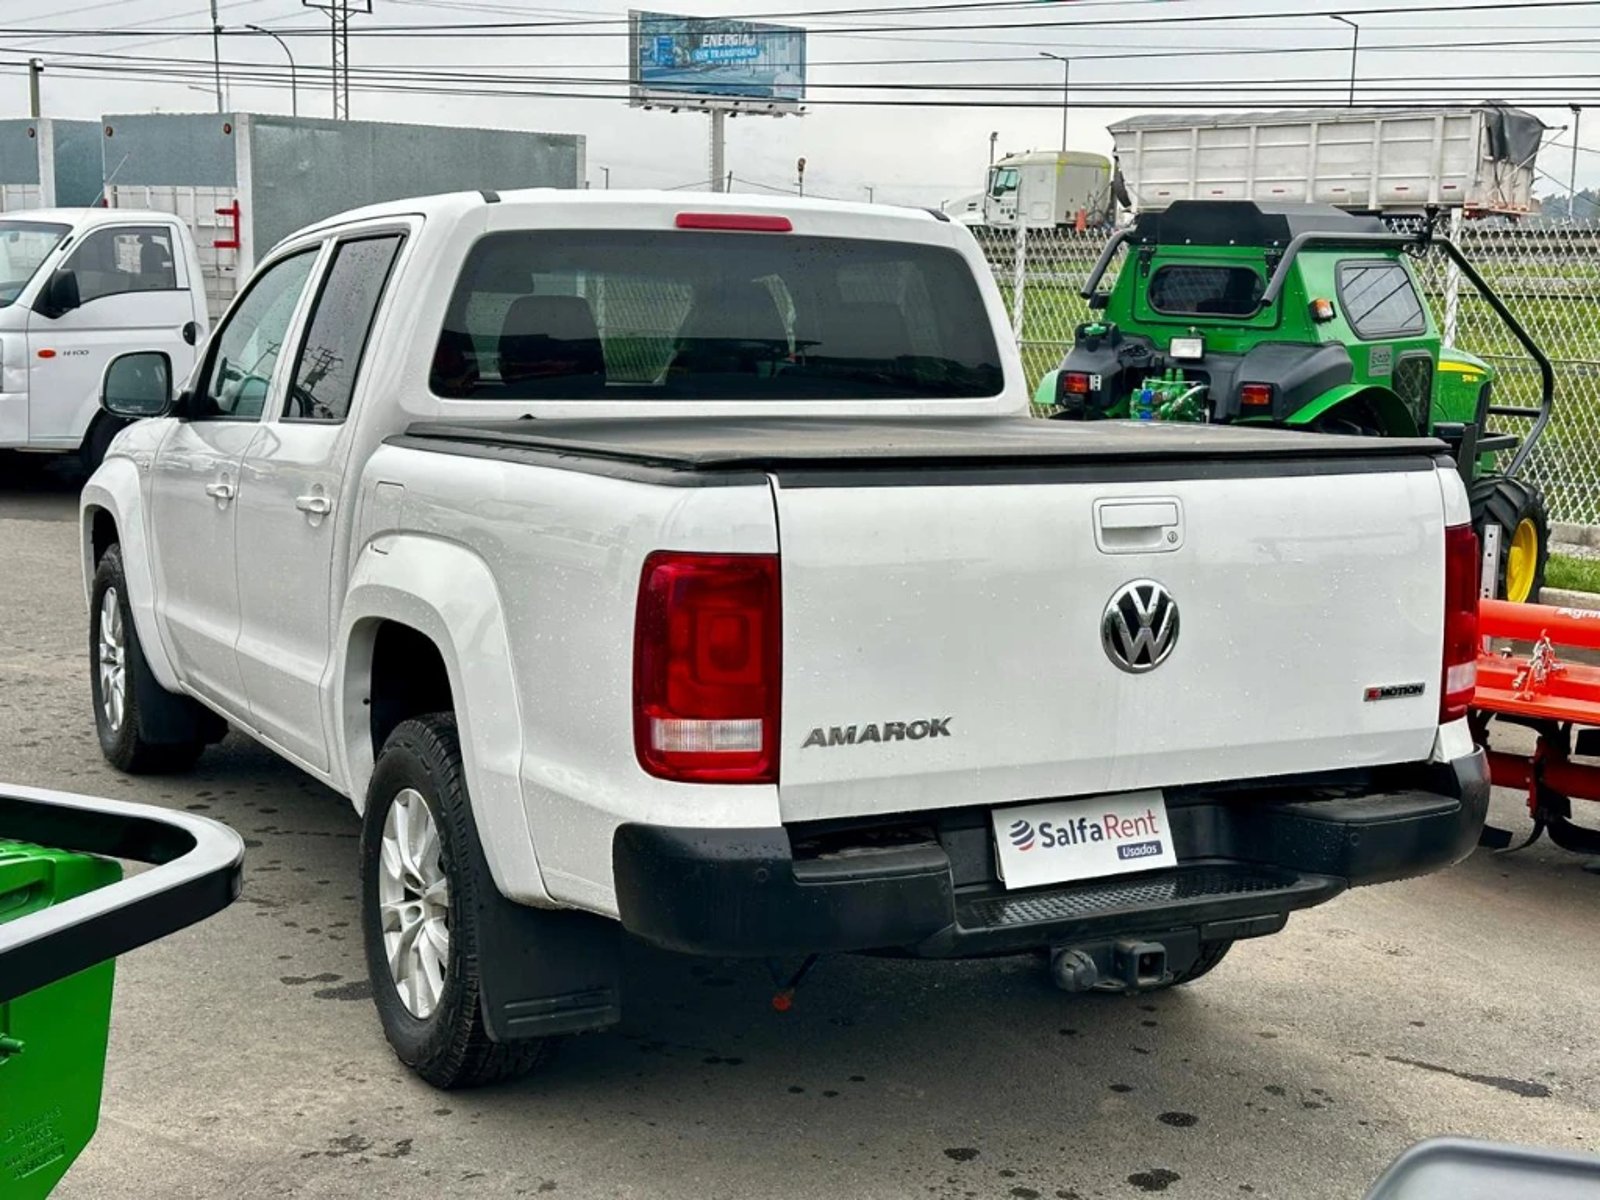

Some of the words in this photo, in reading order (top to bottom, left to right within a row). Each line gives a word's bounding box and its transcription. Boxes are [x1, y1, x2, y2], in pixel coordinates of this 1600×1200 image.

[800, 716, 952, 749] AMAROK
[1038, 808, 1160, 849] SalfaRent
[1122, 844, 1157, 858] Usados
